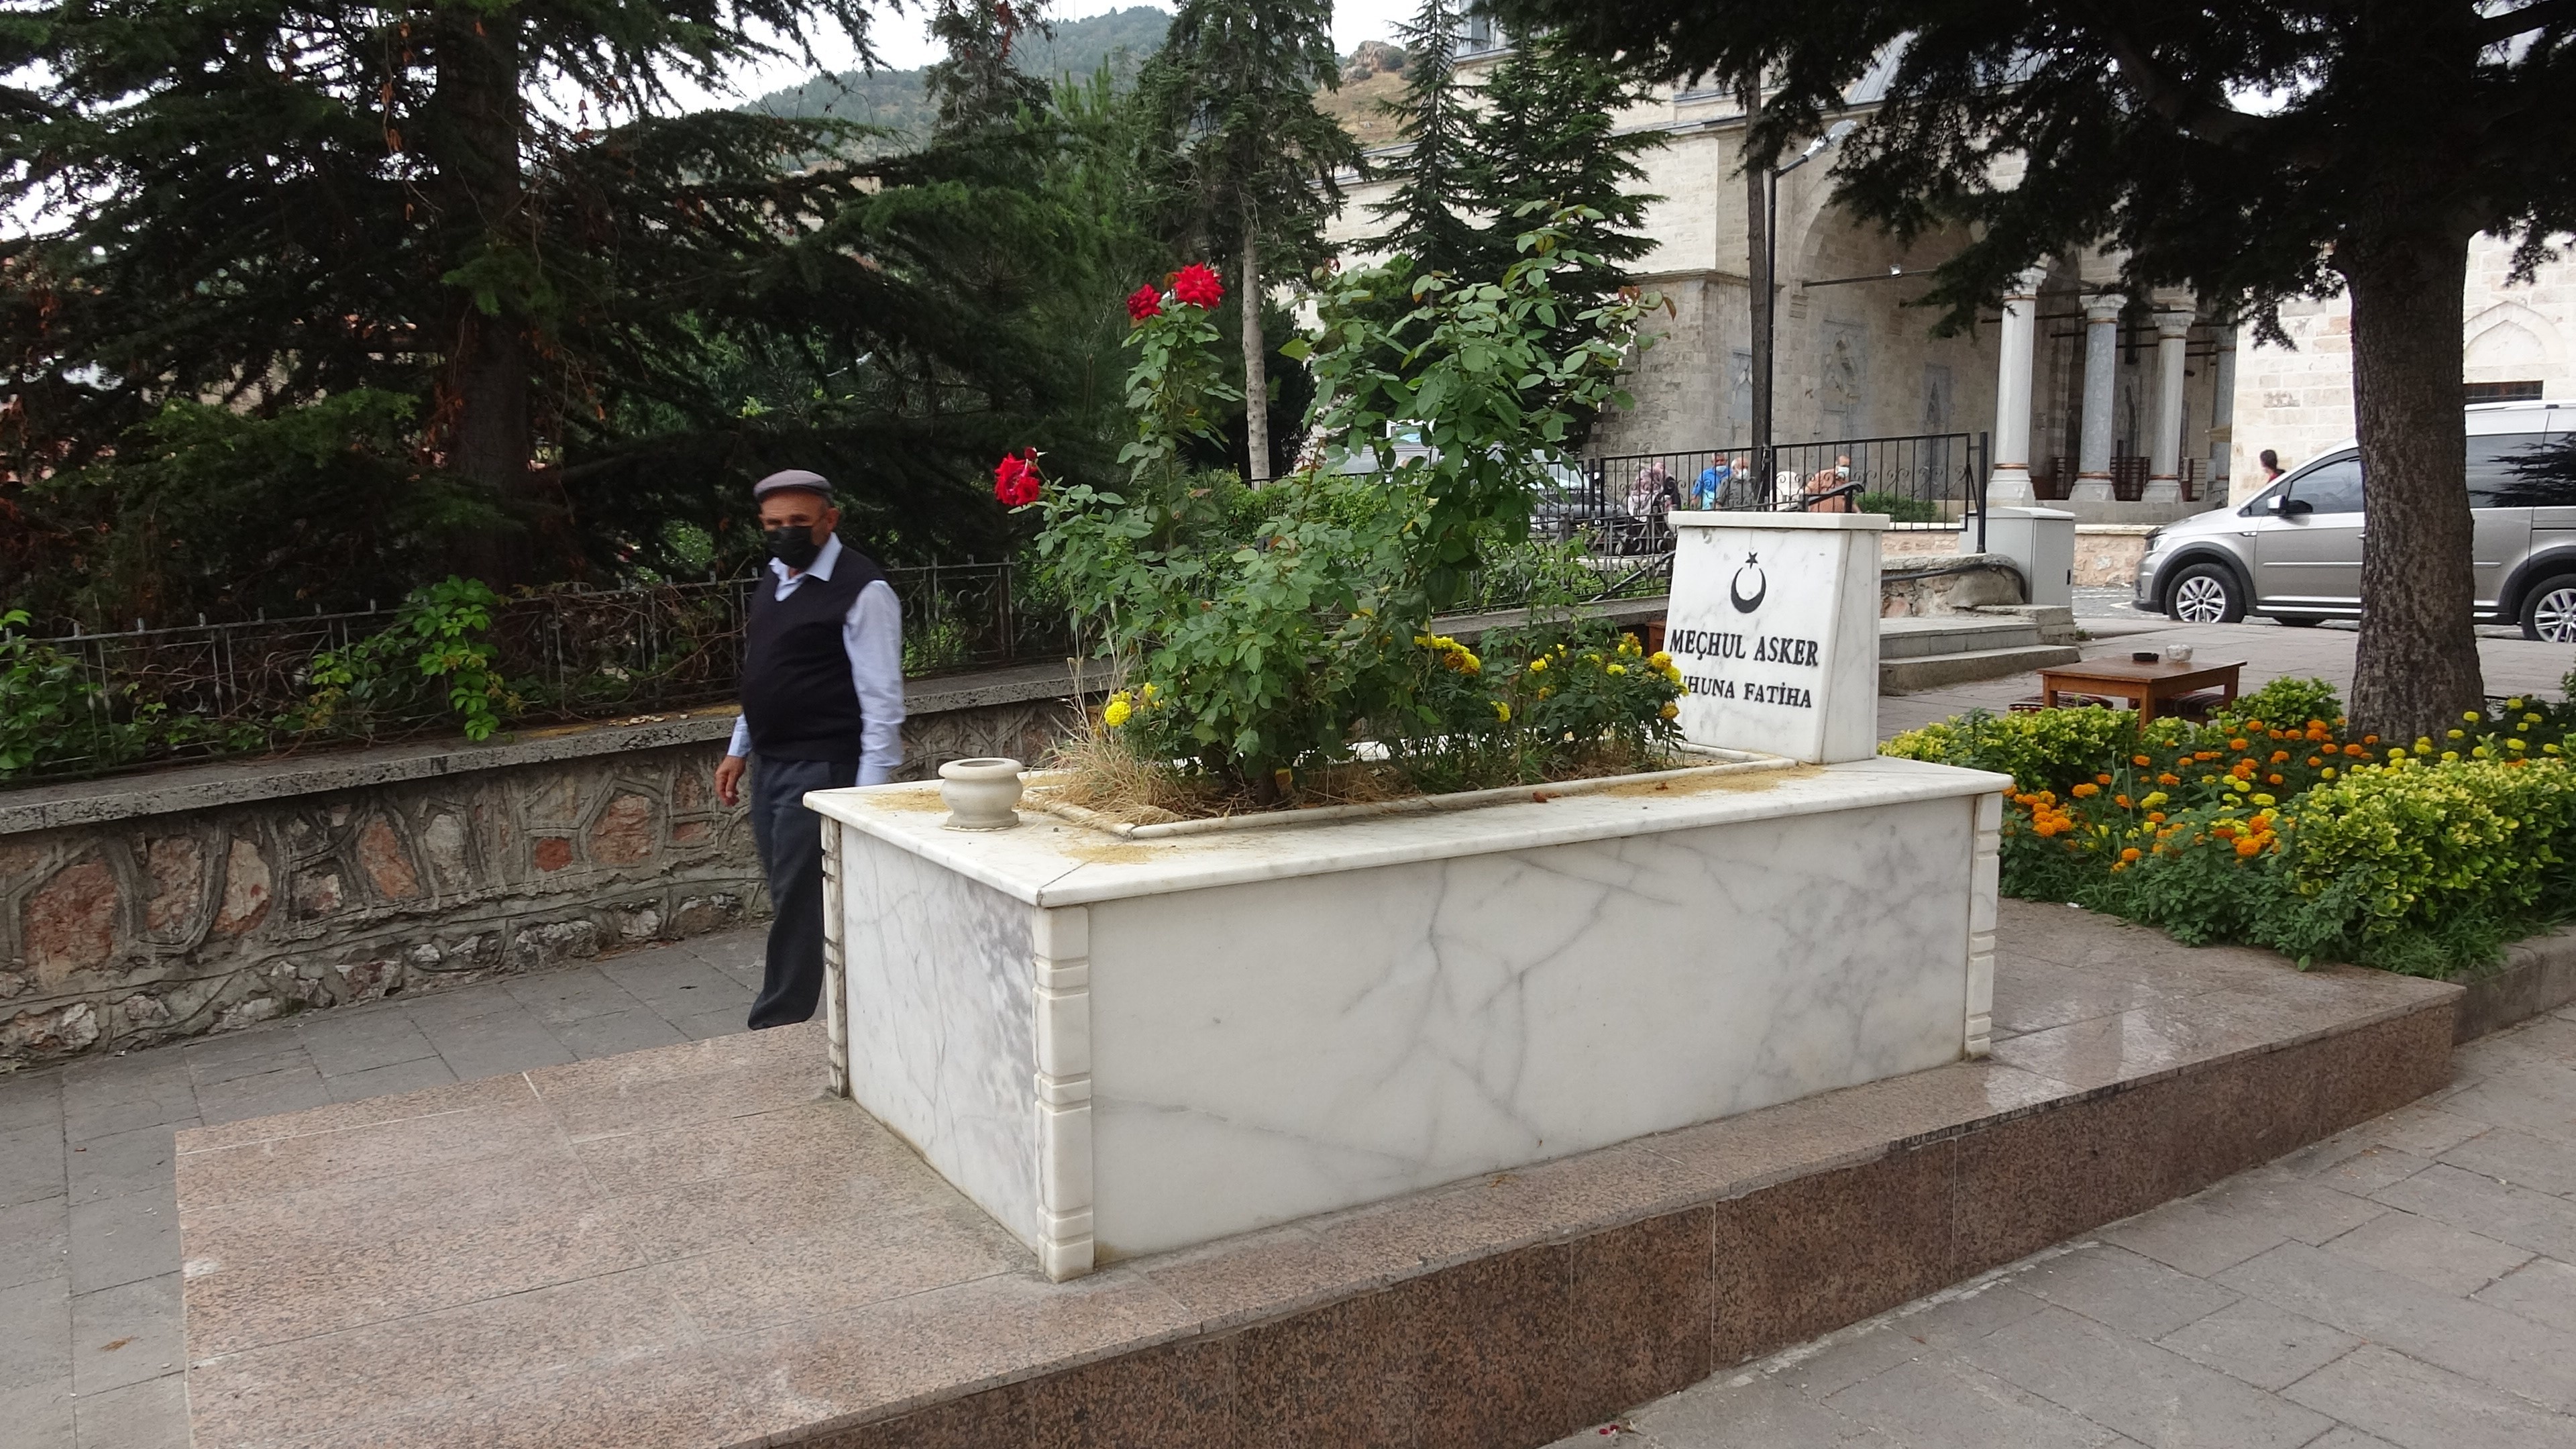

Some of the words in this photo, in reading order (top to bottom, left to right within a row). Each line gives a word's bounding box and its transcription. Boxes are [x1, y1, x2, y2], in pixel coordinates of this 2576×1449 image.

[1669, 629, 1746, 660] MEÇHUL
[1753, 636, 1819, 666] ASKER
[1743, 682, 1812, 708] FATİHA
